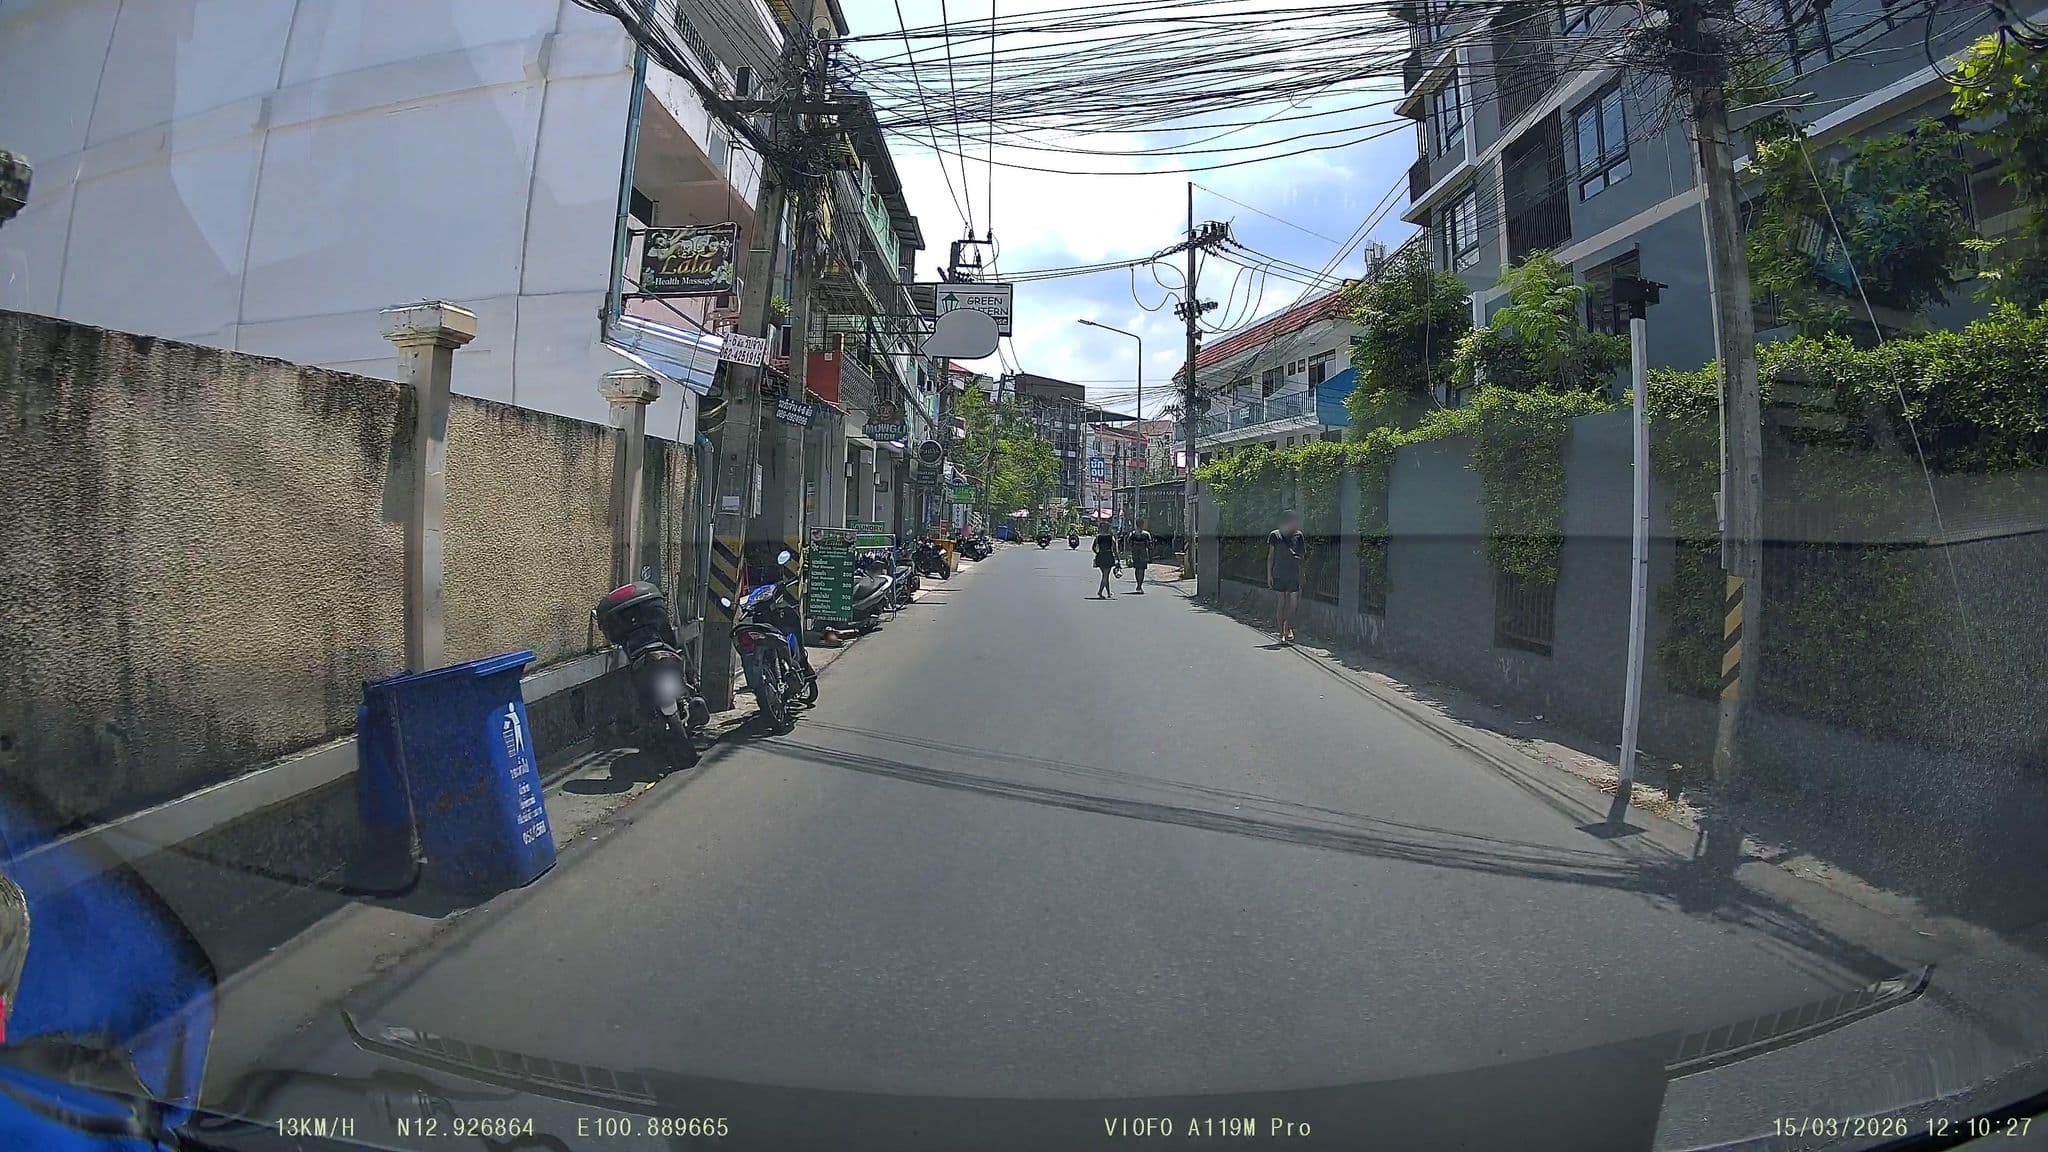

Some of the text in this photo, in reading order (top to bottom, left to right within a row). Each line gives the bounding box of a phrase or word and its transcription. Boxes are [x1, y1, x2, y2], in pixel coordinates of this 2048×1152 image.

[658, 254, 713, 275] Lala
[655, 277, 680, 286] Health
[967, 296, 1003, 306] GREEN
